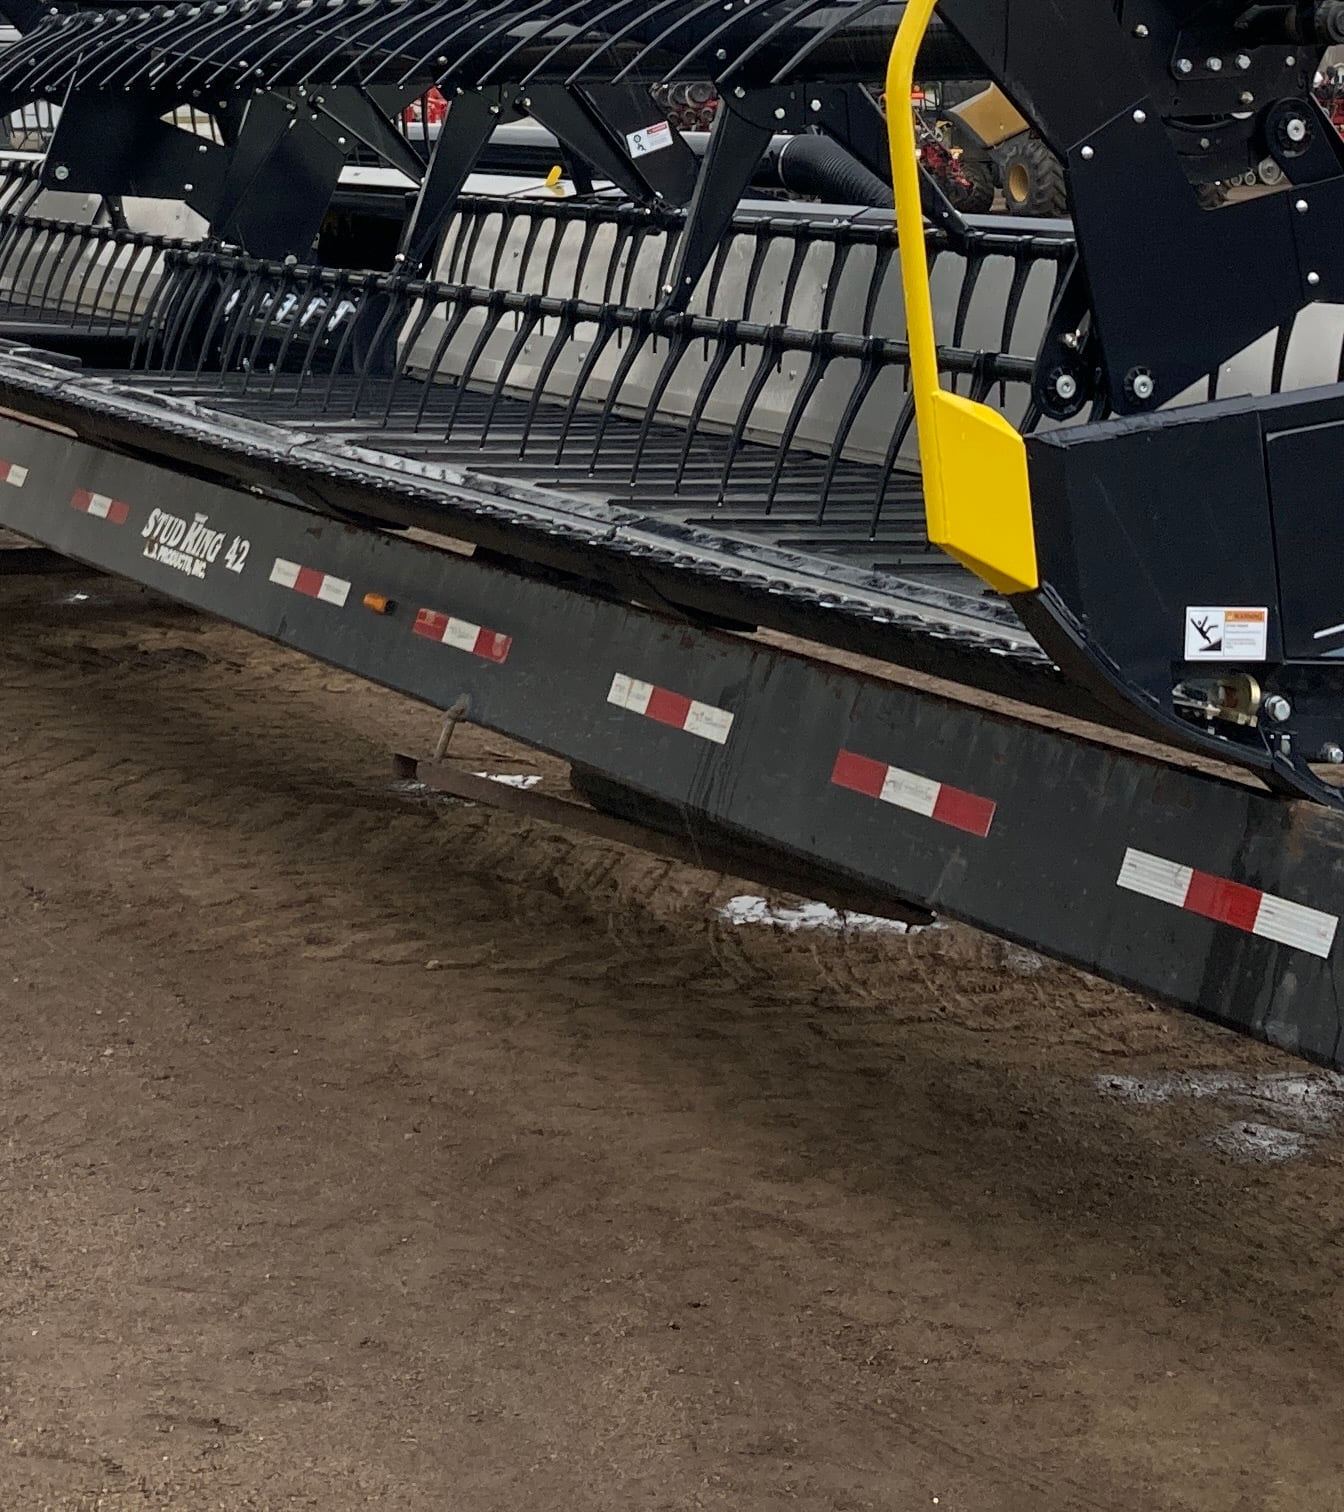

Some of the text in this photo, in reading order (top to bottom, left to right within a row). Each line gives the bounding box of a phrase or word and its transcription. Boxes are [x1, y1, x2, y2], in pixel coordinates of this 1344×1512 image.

[141, 507, 187, 547] STUD
[180, 520, 226, 563] KING
[224, 535, 251, 574] 42
